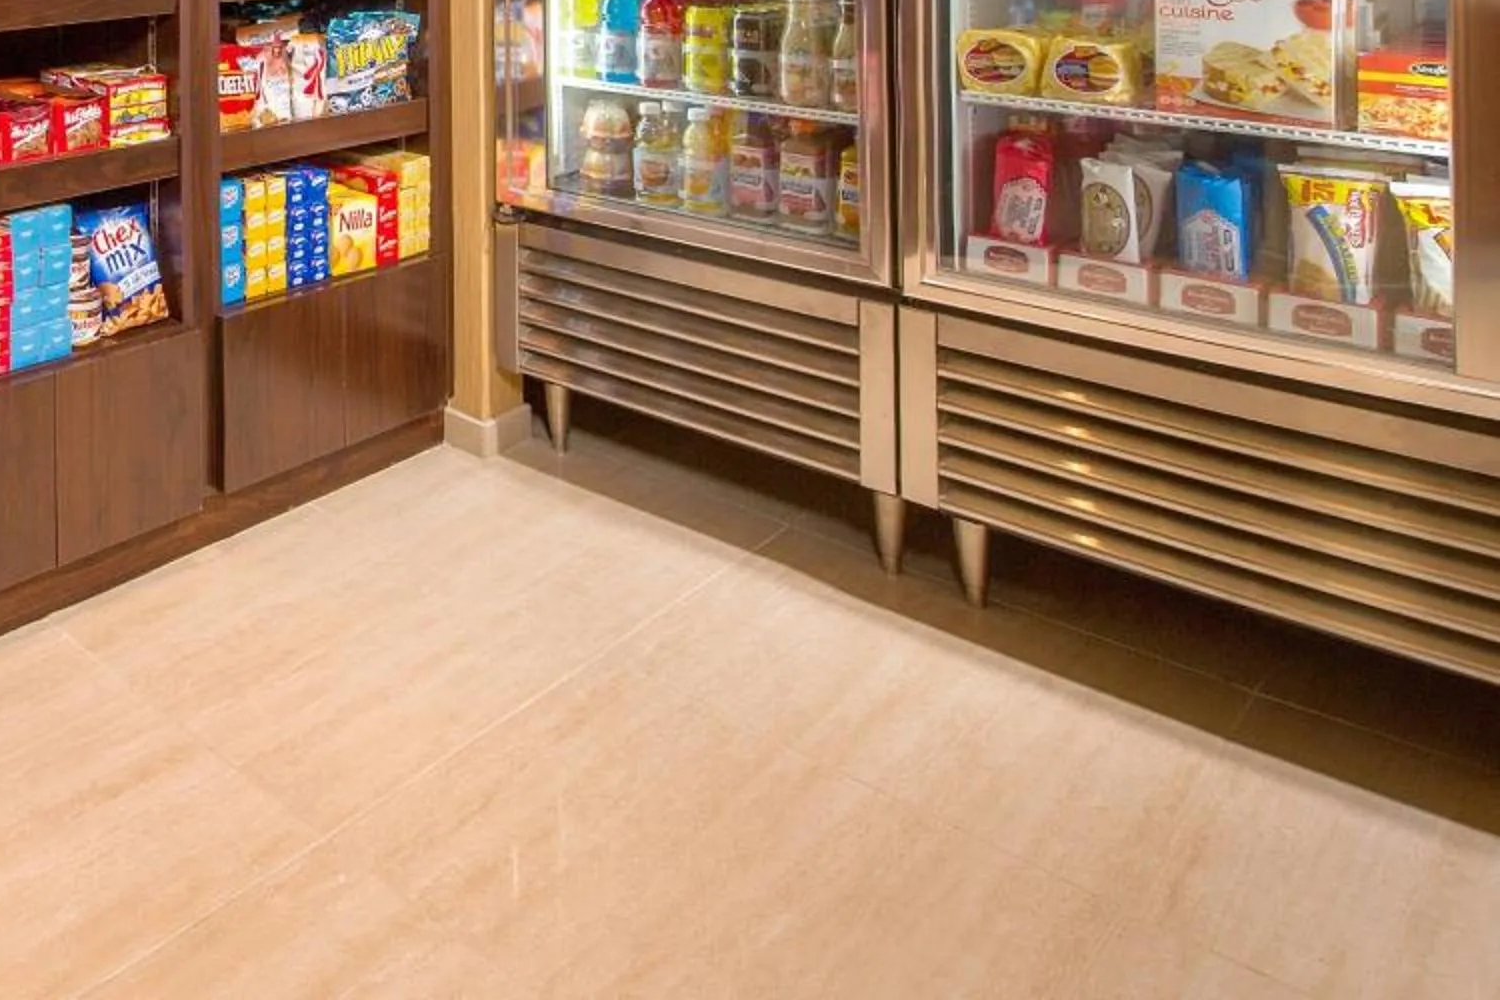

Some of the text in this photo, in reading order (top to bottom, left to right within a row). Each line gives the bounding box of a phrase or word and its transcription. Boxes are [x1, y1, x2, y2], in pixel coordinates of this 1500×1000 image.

[1159, 4, 1235, 21] cuisine
[338, 206, 374, 233] Nilla
[91, 213, 141, 256] Chex
